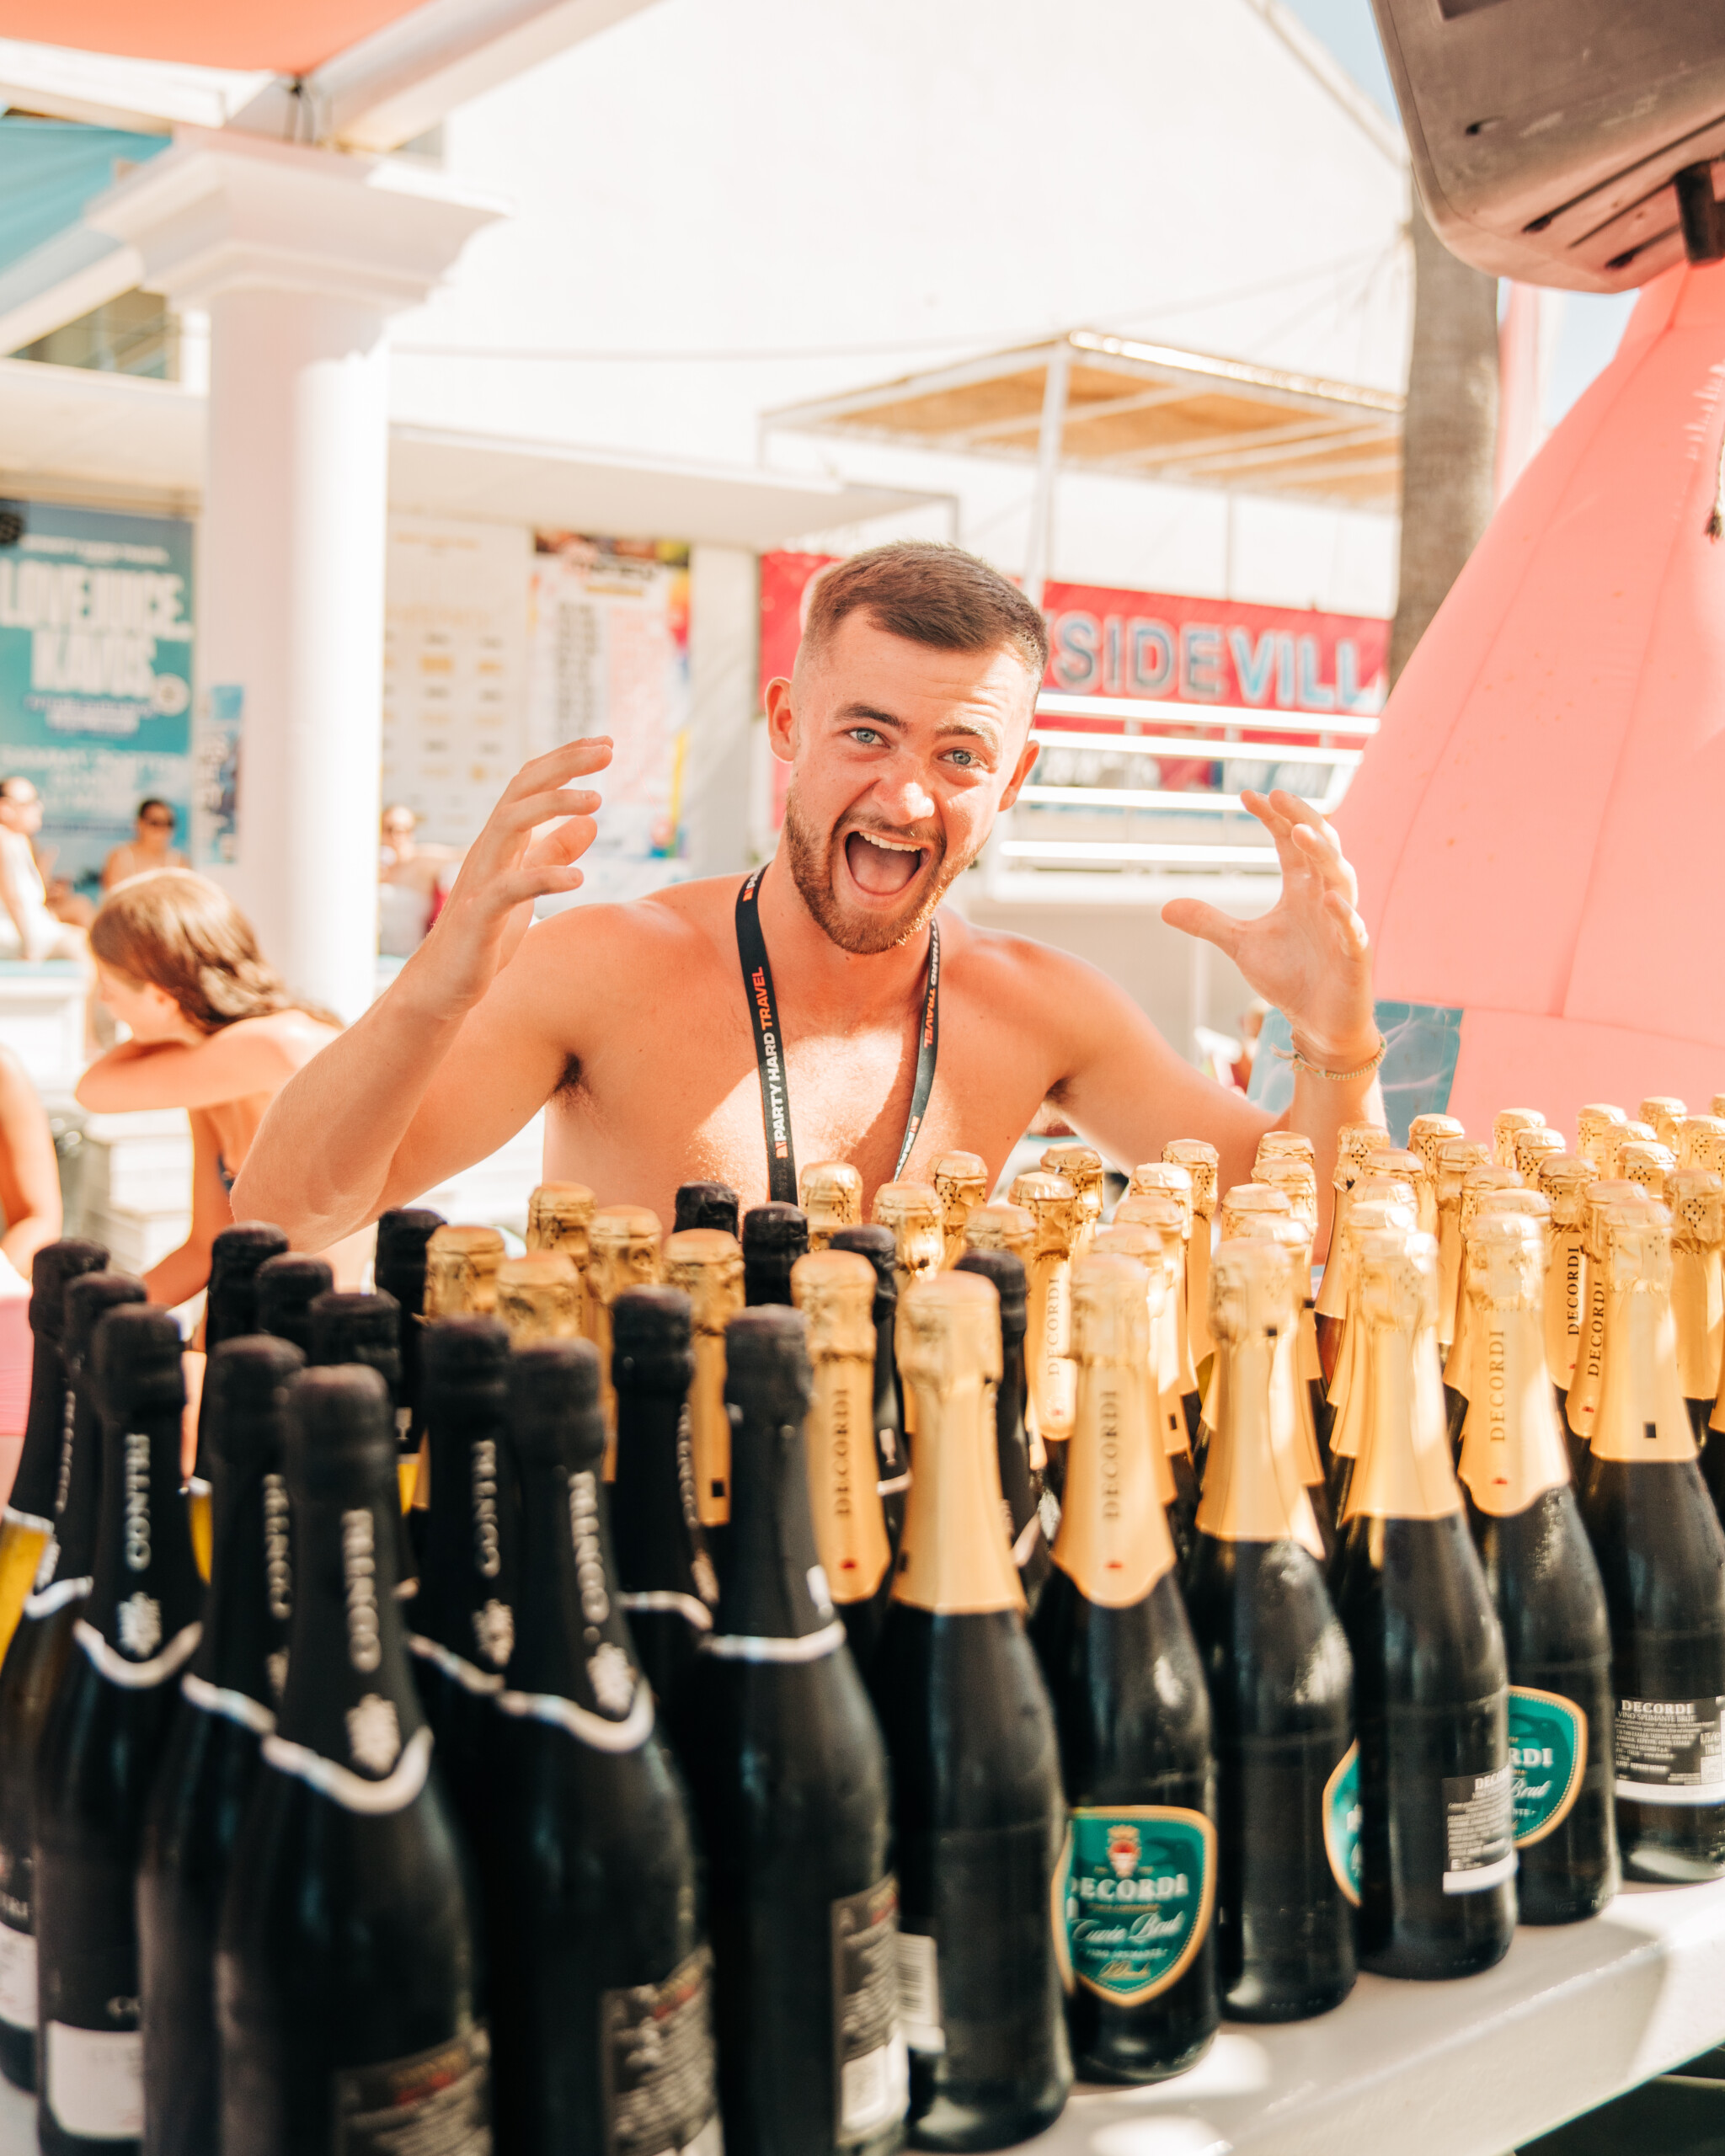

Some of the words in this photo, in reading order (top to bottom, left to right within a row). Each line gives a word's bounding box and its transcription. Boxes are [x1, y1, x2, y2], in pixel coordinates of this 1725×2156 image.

[1044, 608, 1228, 702] SIDE
[751, 966, 772, 1031] TRAVEL
[923, 988, 937, 1049] TRAVEL
[763, 1032, 781, 1081] HARD
[769, 1083, 787, 1142] PARTY
[1046, 1278, 1060, 1376] DECORDI
[1567, 1247, 1580, 1336] DECORDI
[1587, 1281, 1605, 1378] DECORDI
[1489, 1330, 1505, 1443] DECORDI
[832, 1389, 852, 1518] DECORDI
[1100, 1390, 1120, 1519] DECORDI
[1618, 1711, 1636, 1720] VINO
[1637, 1714, 1676, 1723] SPUMANTE
[1676, 1715, 1696, 1723] BRUT
[1621, 1700, 1696, 1715] DECORDI
